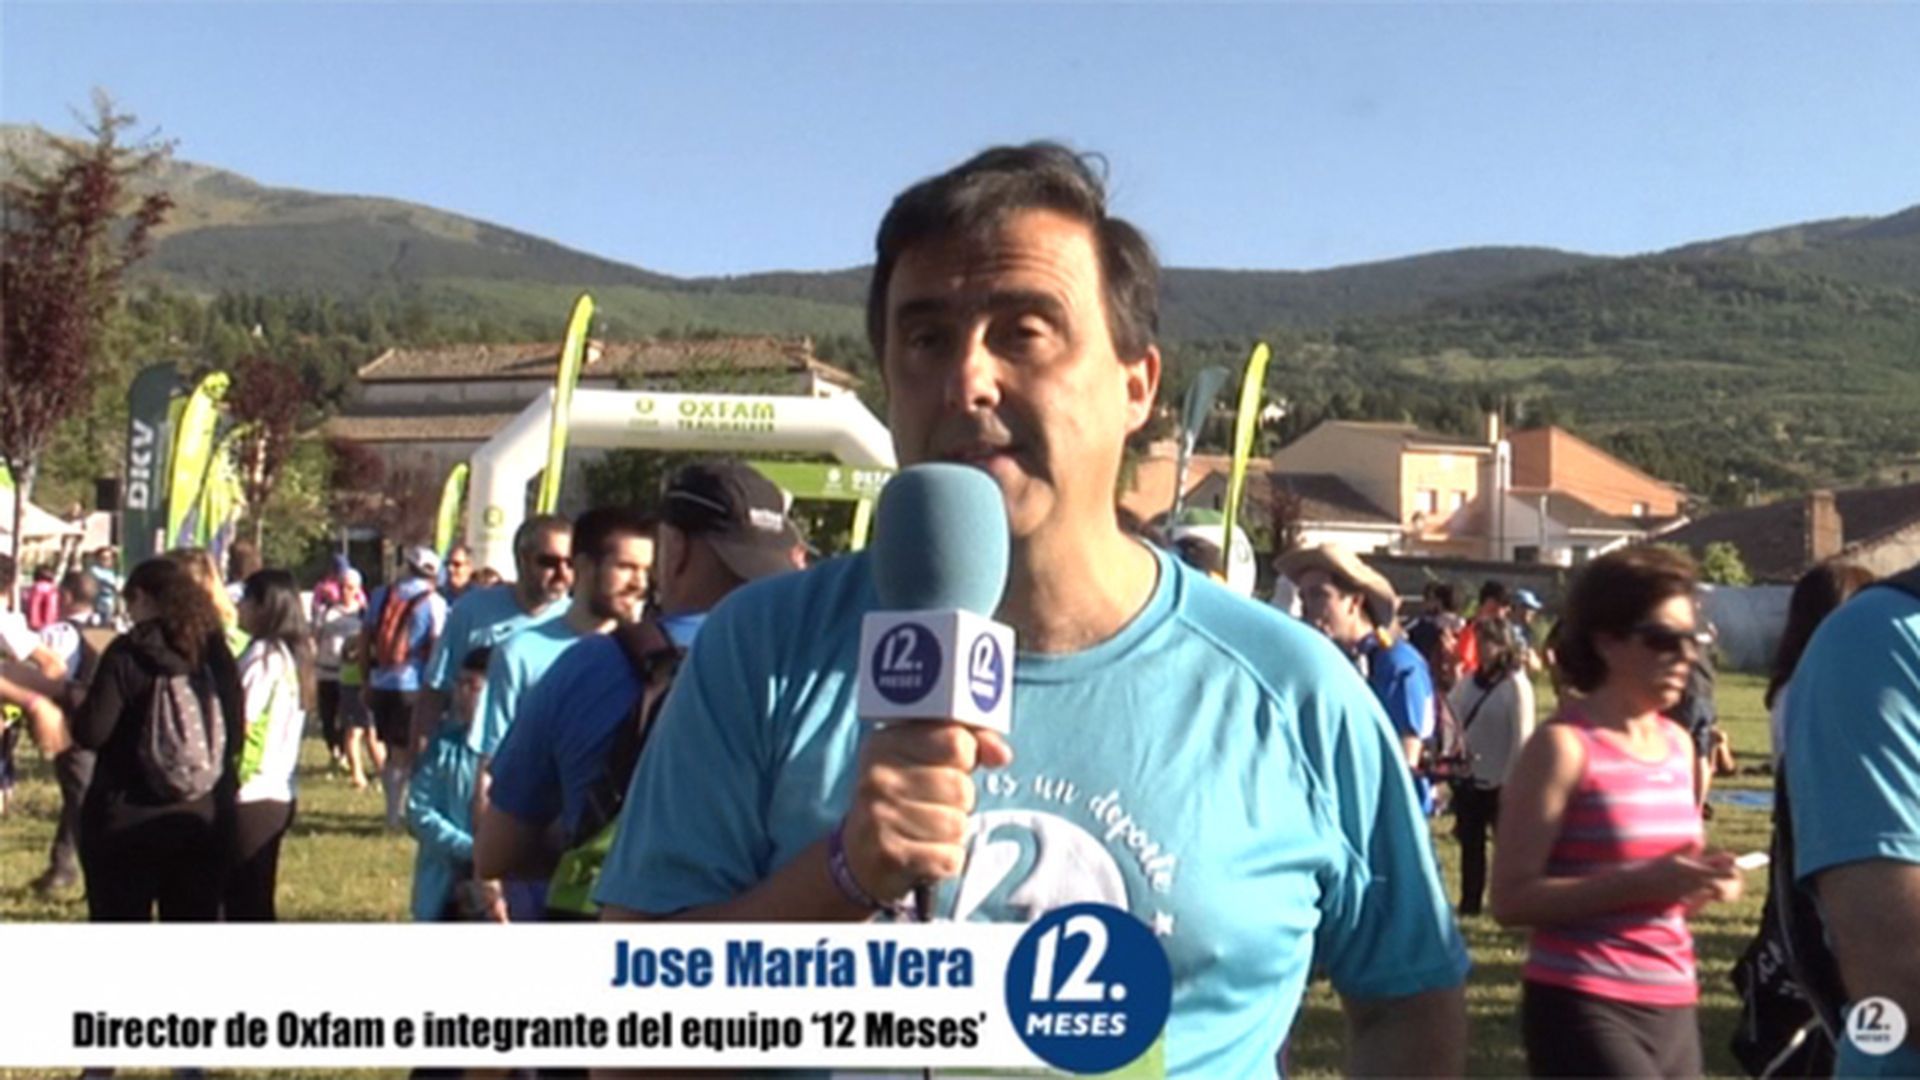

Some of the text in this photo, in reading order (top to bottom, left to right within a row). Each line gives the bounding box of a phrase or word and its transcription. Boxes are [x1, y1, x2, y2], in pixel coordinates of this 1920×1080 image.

[678, 400, 775, 420] OXFAM
[127, 419, 154, 510] DKV
[986, 773, 1175, 894] es un deporte
